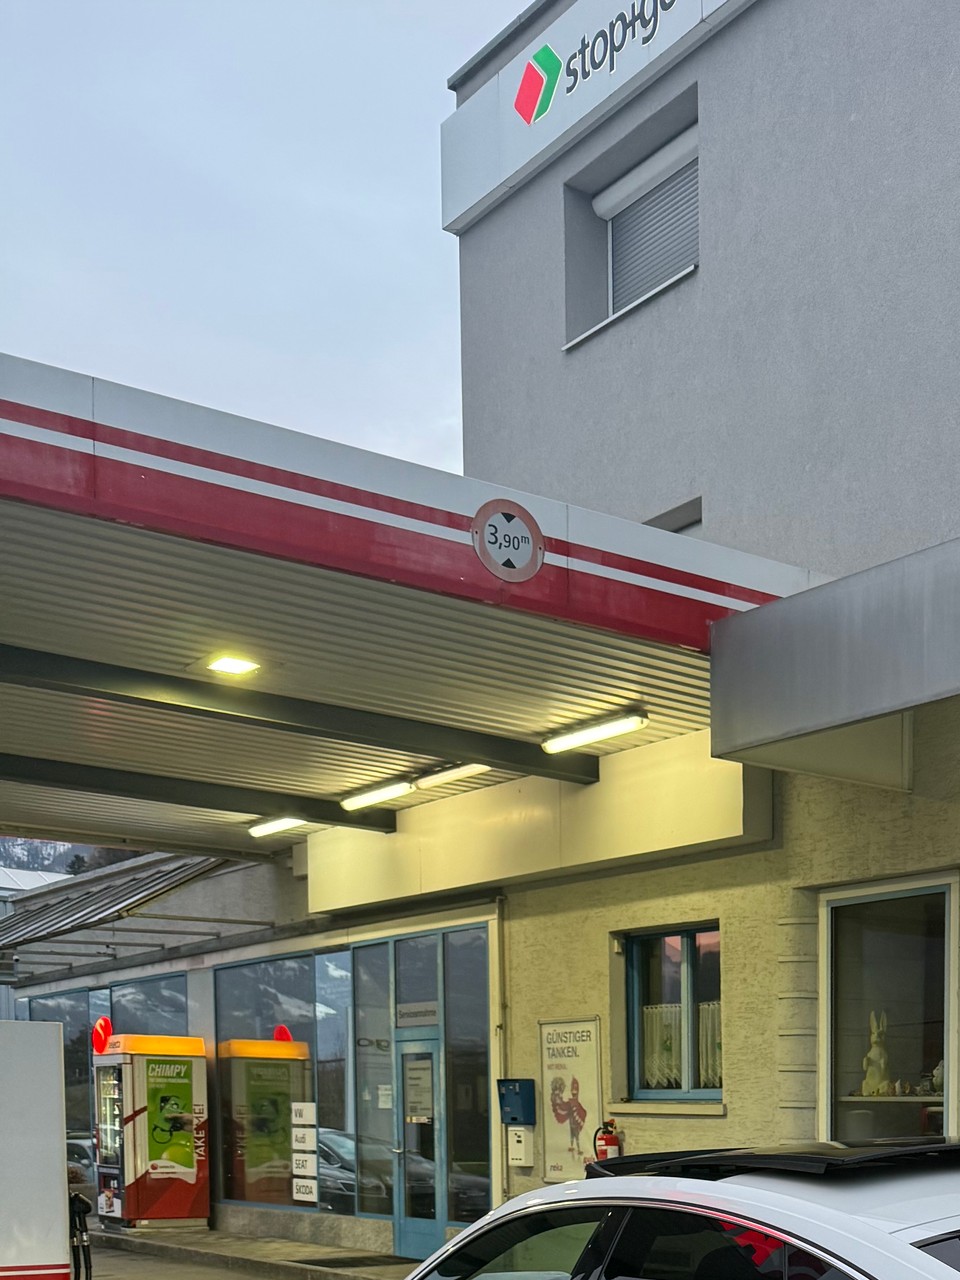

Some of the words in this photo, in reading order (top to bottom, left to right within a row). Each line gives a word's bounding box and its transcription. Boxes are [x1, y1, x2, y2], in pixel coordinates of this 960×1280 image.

[546, 1029, 592, 1044] GÜNSTIGER
[546, 1046, 580, 1058] TANKEN.
[148, 1064, 187, 1077] CHIMPY
[294, 1108, 304, 1118] VW
[194, 1130, 205, 1160] TAKE
[295, 1134, 306, 1144] Audi
[295, 1159, 308, 1169] SEAT
